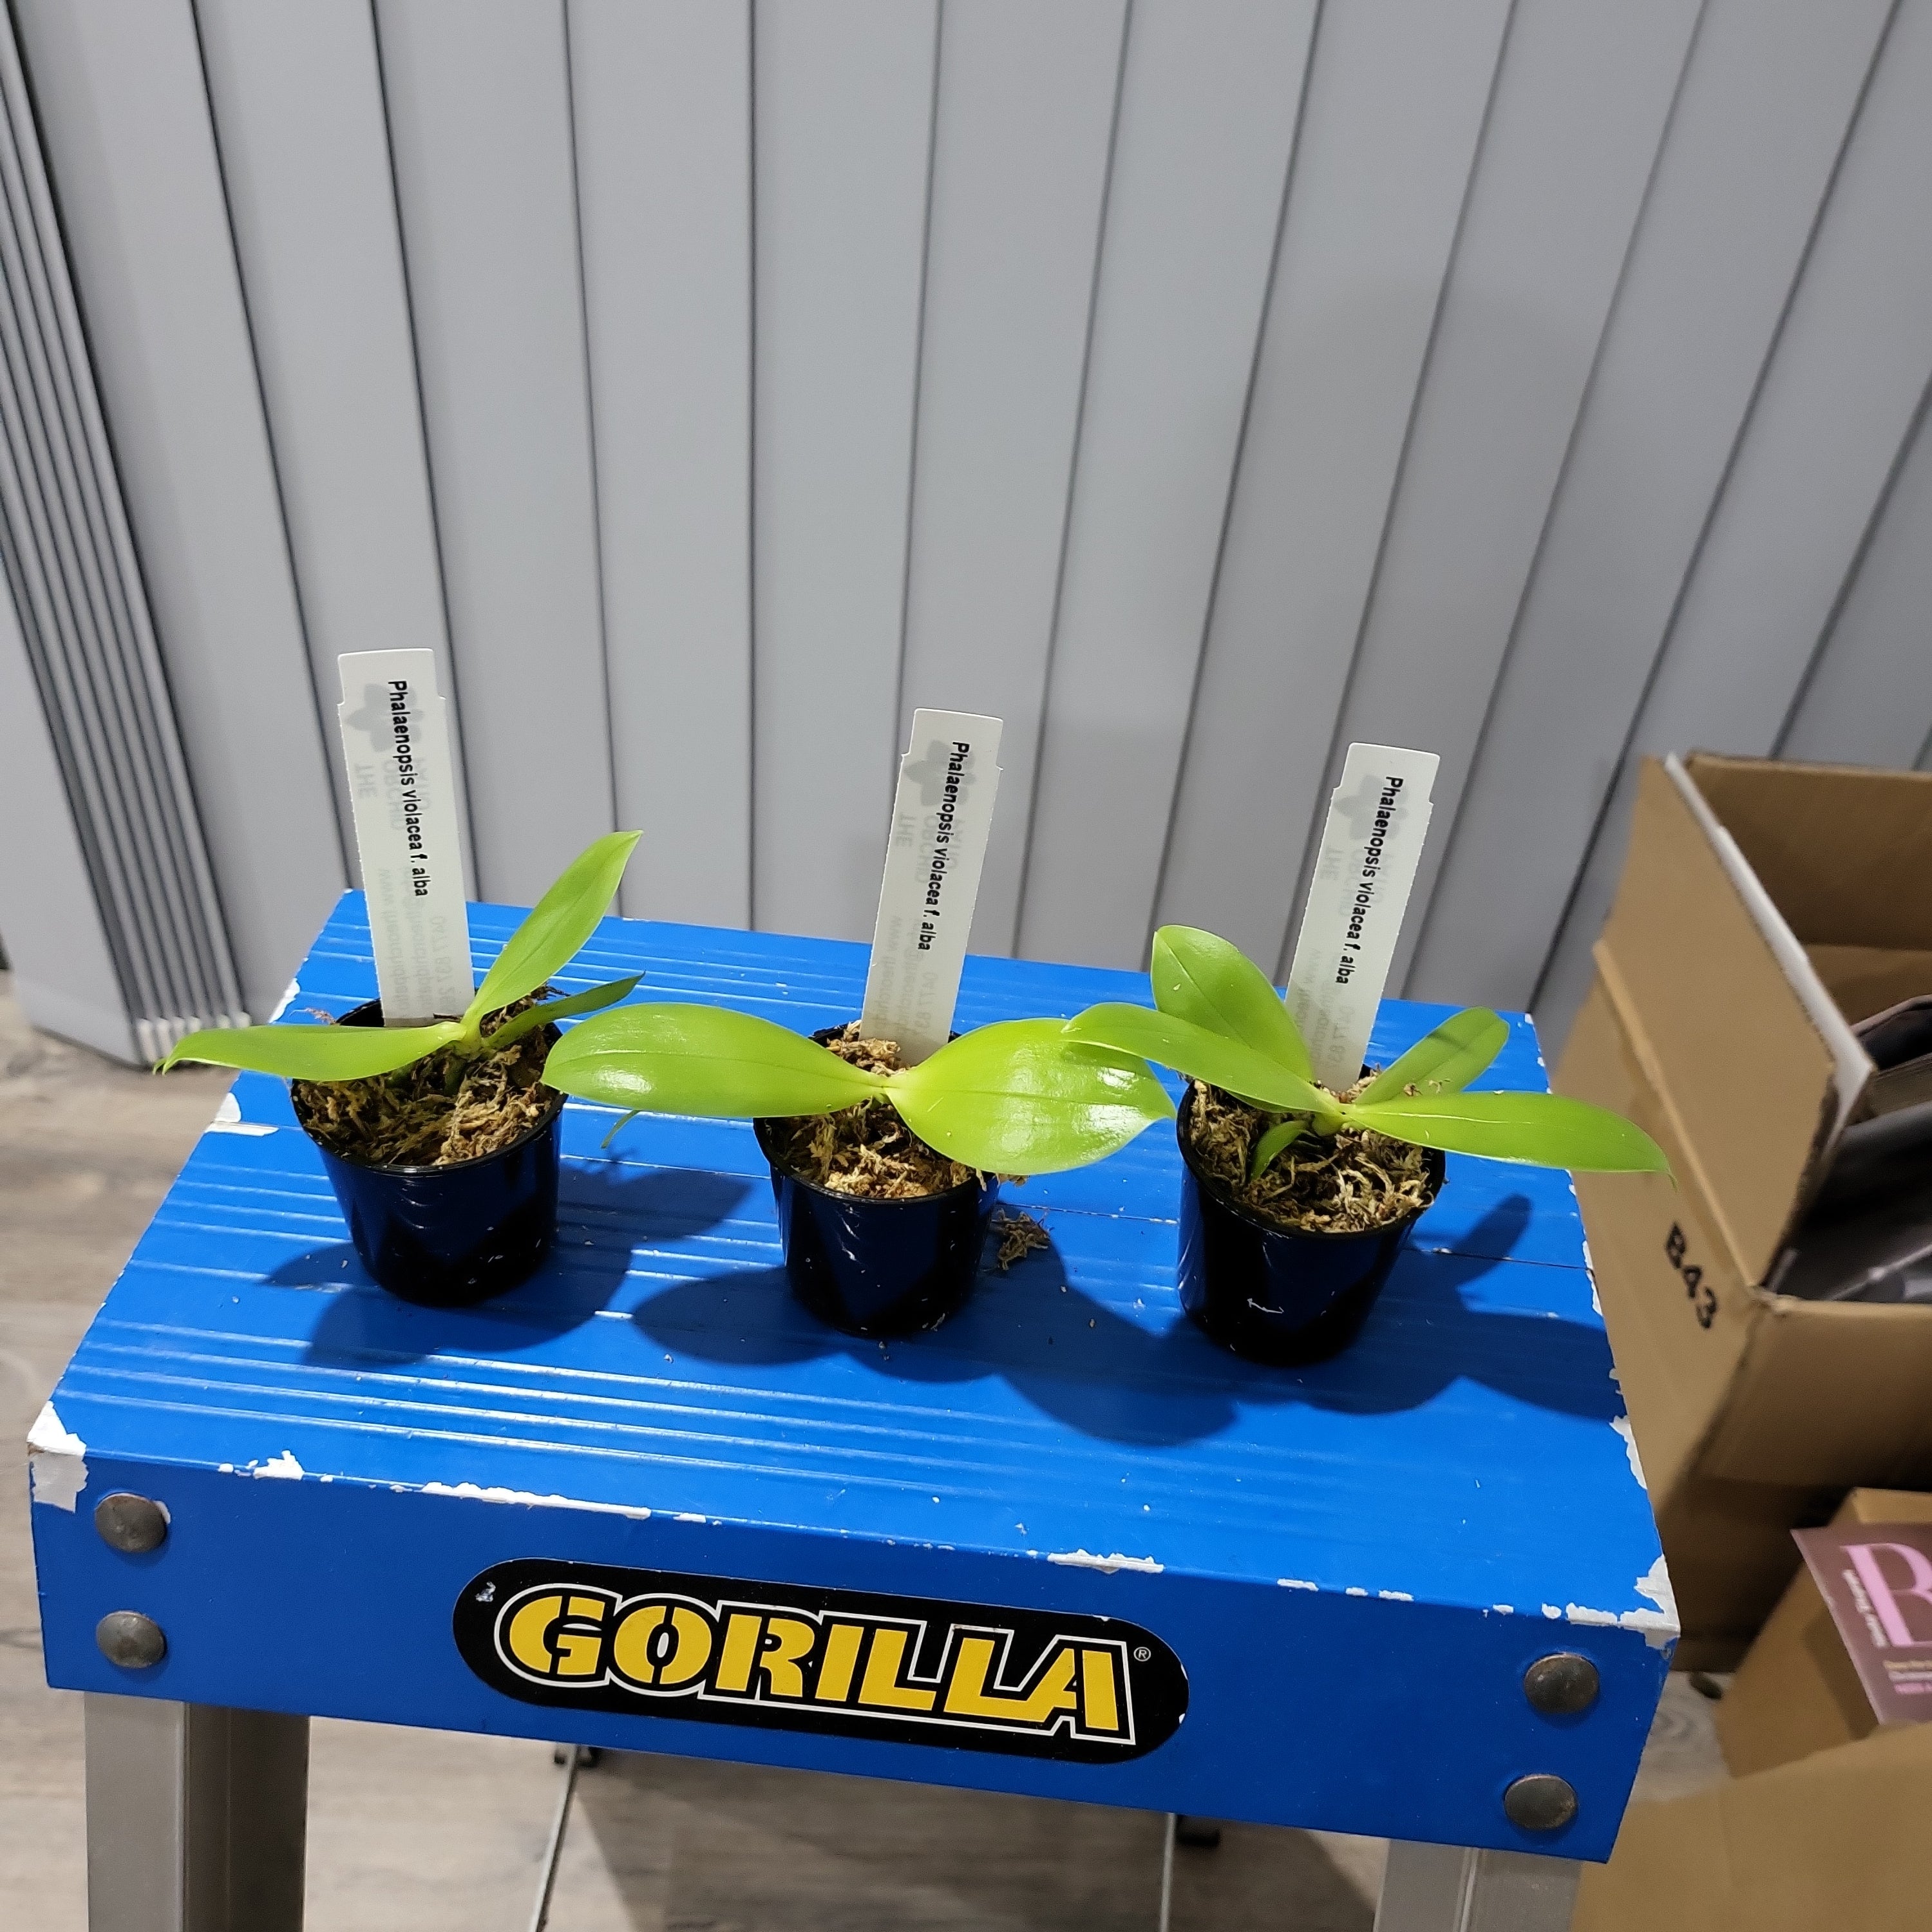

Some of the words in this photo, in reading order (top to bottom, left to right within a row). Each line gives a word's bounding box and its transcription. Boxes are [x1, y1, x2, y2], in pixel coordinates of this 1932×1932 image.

[388, 681, 417, 786] Phalaenopsis
[402, 790, 422, 850] violacea
[936, 741, 970, 844] Phalaenopsis
[1362, 776, 1404, 878] Phalaenopsis
[410, 853, 428, 863] f.
[412, 867, 431, 896] alba
[925, 848, 950, 905] violacea
[918, 922, 936, 951] alba
[1347, 882, 1374, 940] violacea
[1335, 956, 1356, 984] alba
[1665, 1222, 1718, 1330] B43
[495, 1583, 1136, 1745] GORILLA
